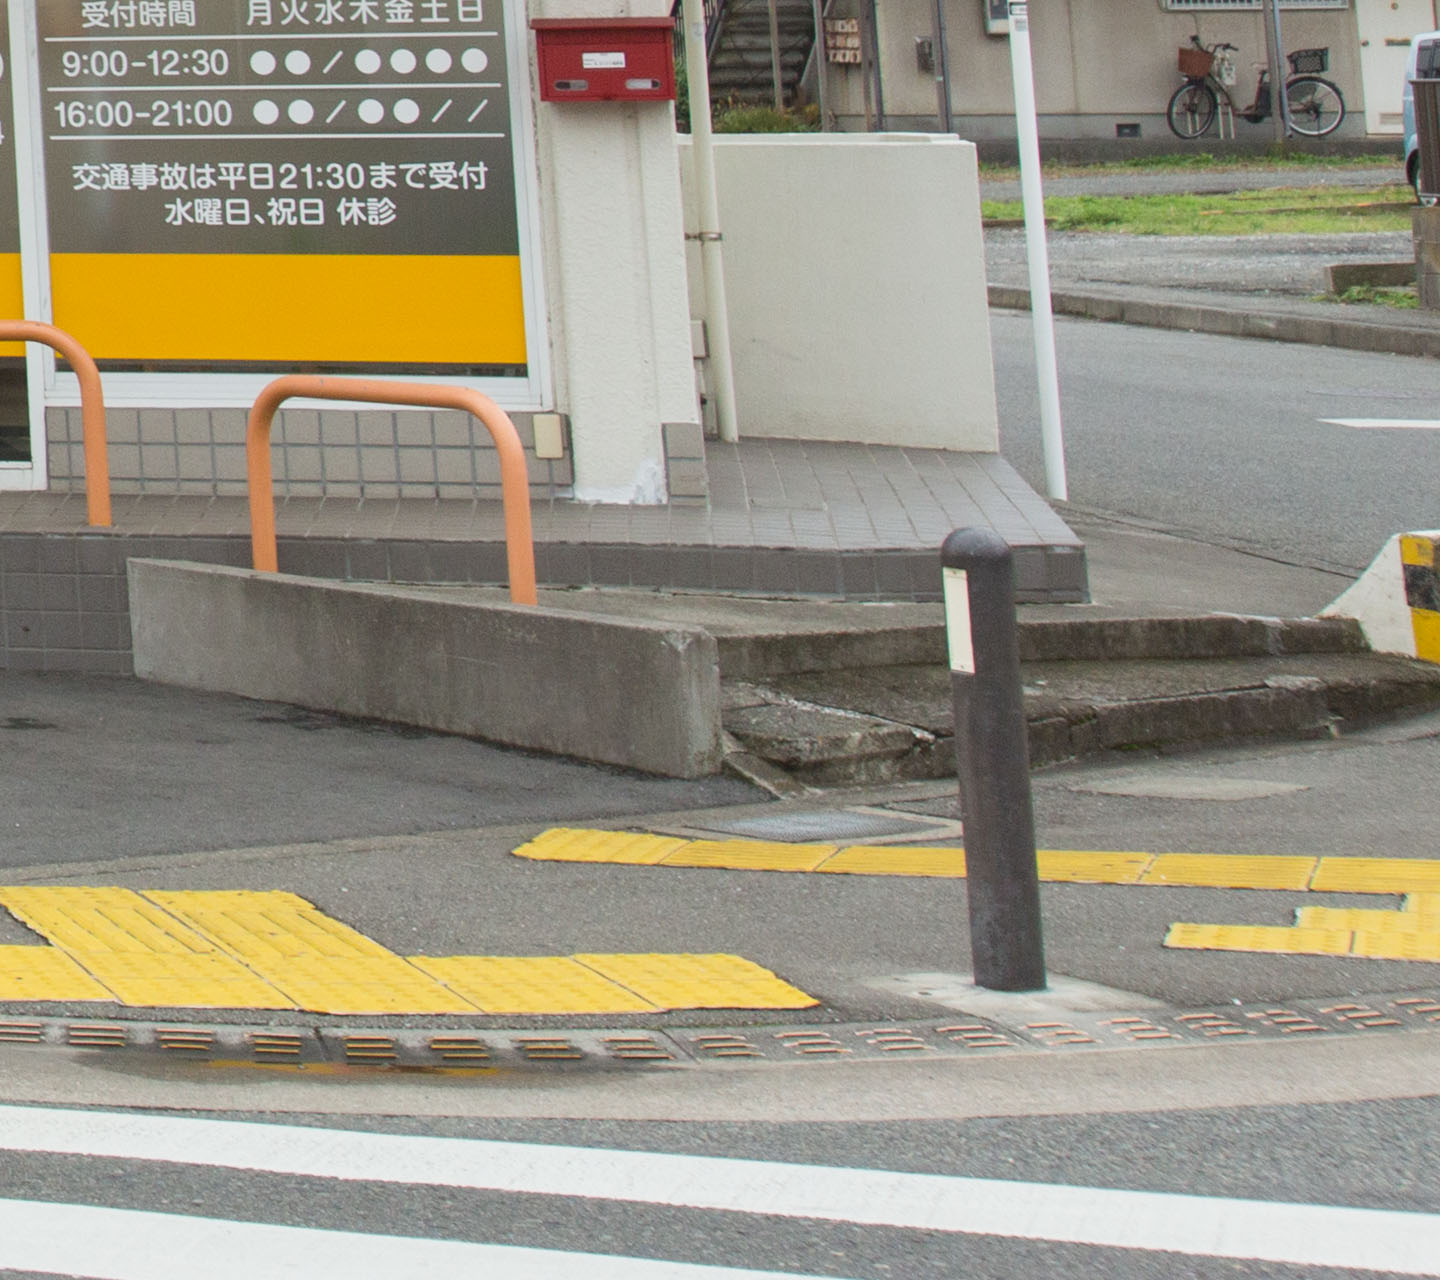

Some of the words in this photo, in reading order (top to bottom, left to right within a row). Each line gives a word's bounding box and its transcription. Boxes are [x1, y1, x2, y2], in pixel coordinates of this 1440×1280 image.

[81, 0, 196, 28] 受付時間
[62, 48, 229, 78] 9:00-12:30
[53, 99, 233, 128] 16:00-21:00
[71, 161, 489, 191] 交通事故は平日21:30まで受付
[164, 197, 325, 226] 水曜日、祝日
[336, 196, 397, 226] 休診
